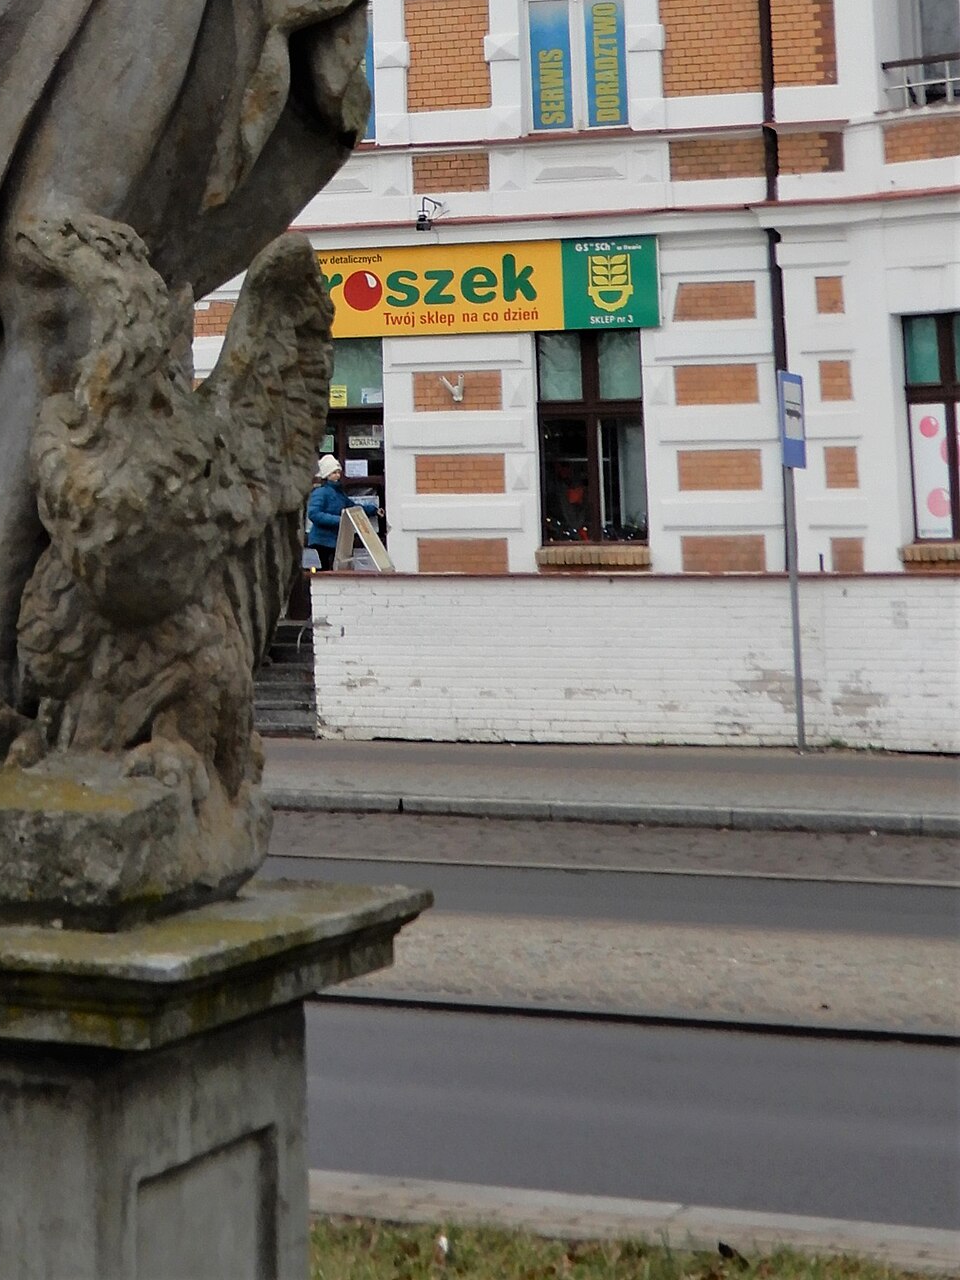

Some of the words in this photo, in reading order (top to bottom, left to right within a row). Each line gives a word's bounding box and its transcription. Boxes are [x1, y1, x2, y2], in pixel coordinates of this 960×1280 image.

[592, 1, 621, 124] DORADZTWO
[539, 48, 566, 125] SERWIS
[330, 254, 383, 265] detalicznych
[319, 253, 537, 312] roszek
[383, 312, 415, 328] Twój
[419, 311, 455, 326] sklep
[462, 312, 478, 323] na
[482, 311, 499, 322] co
[503, 307, 539, 322] dzień
[590, 315, 615, 324] SKLEP
[627, 314, 634, 323] 3
